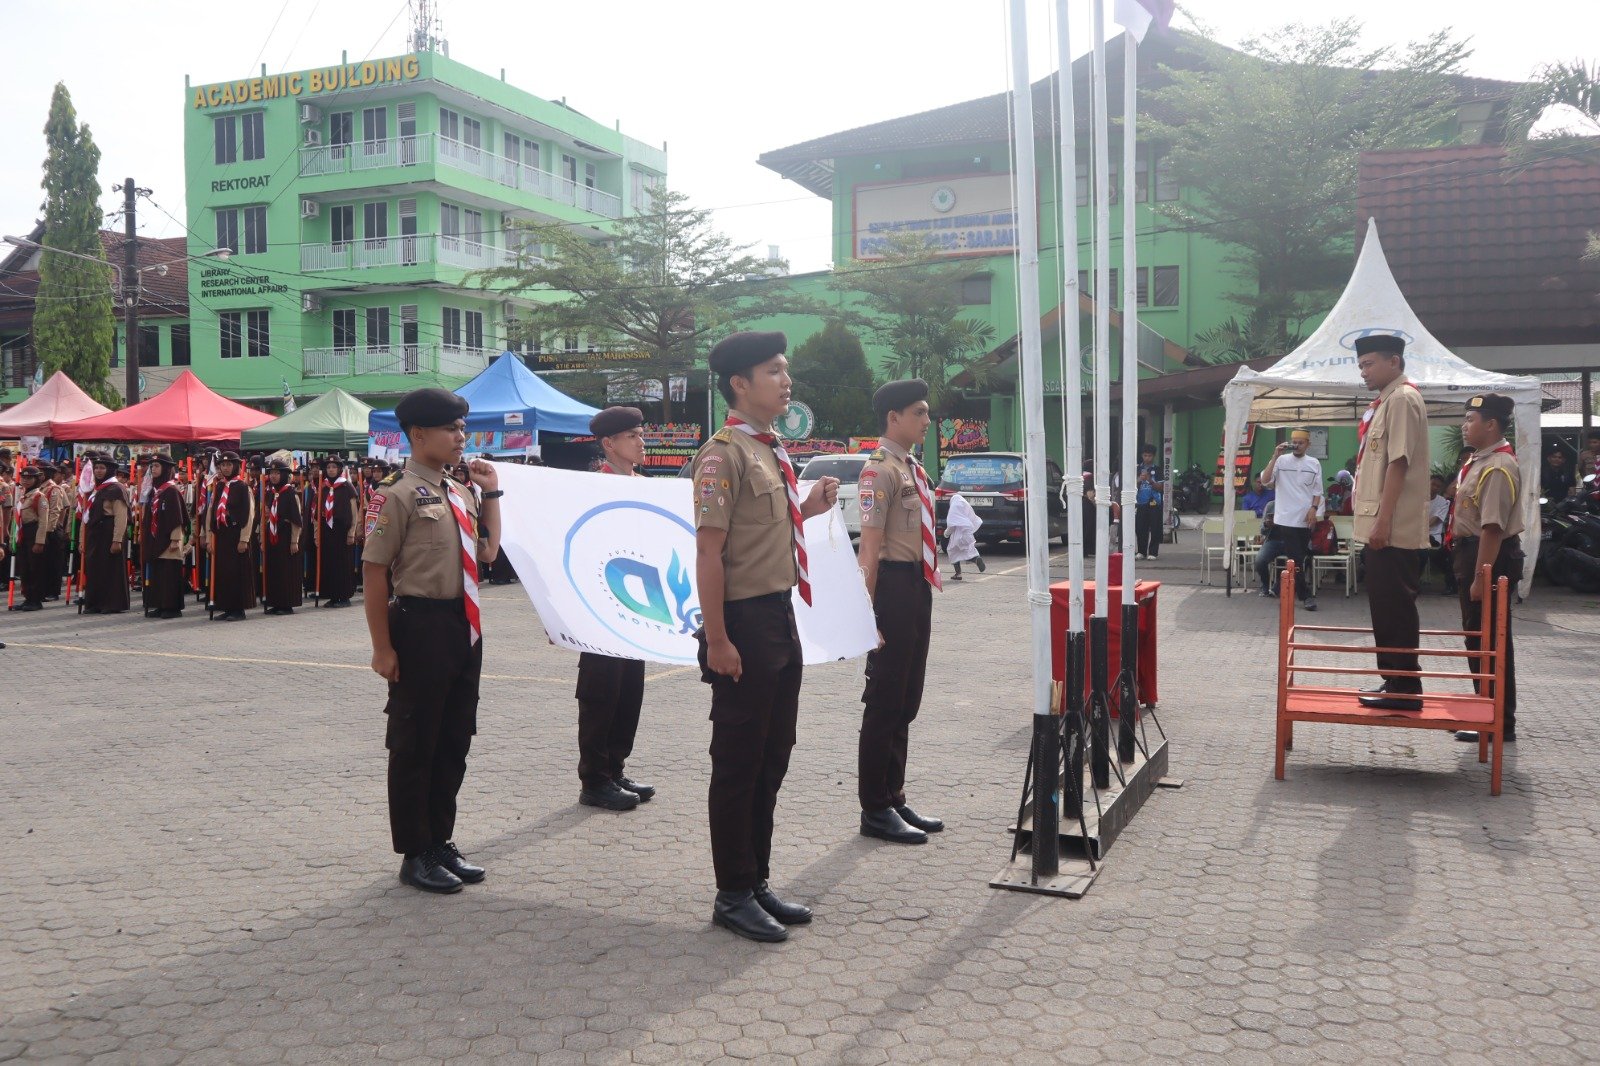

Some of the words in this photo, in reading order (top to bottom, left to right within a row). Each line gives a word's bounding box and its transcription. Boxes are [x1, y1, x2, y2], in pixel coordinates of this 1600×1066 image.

[193, 73, 303, 109] ACADEMIC
[309, 54, 420, 93] BUILDING
[211, 174, 271, 192] REKTORAT
[200, 268, 231, 278] LIBRARY
[201, 277, 239, 287] RESEARCH
[240, 275, 270, 285] CENTER
[201, 286, 257, 298] INTERNATIONAL
[257, 284, 289, 294] AFFAIRS
[1302, 356, 1356, 370] HYUN
